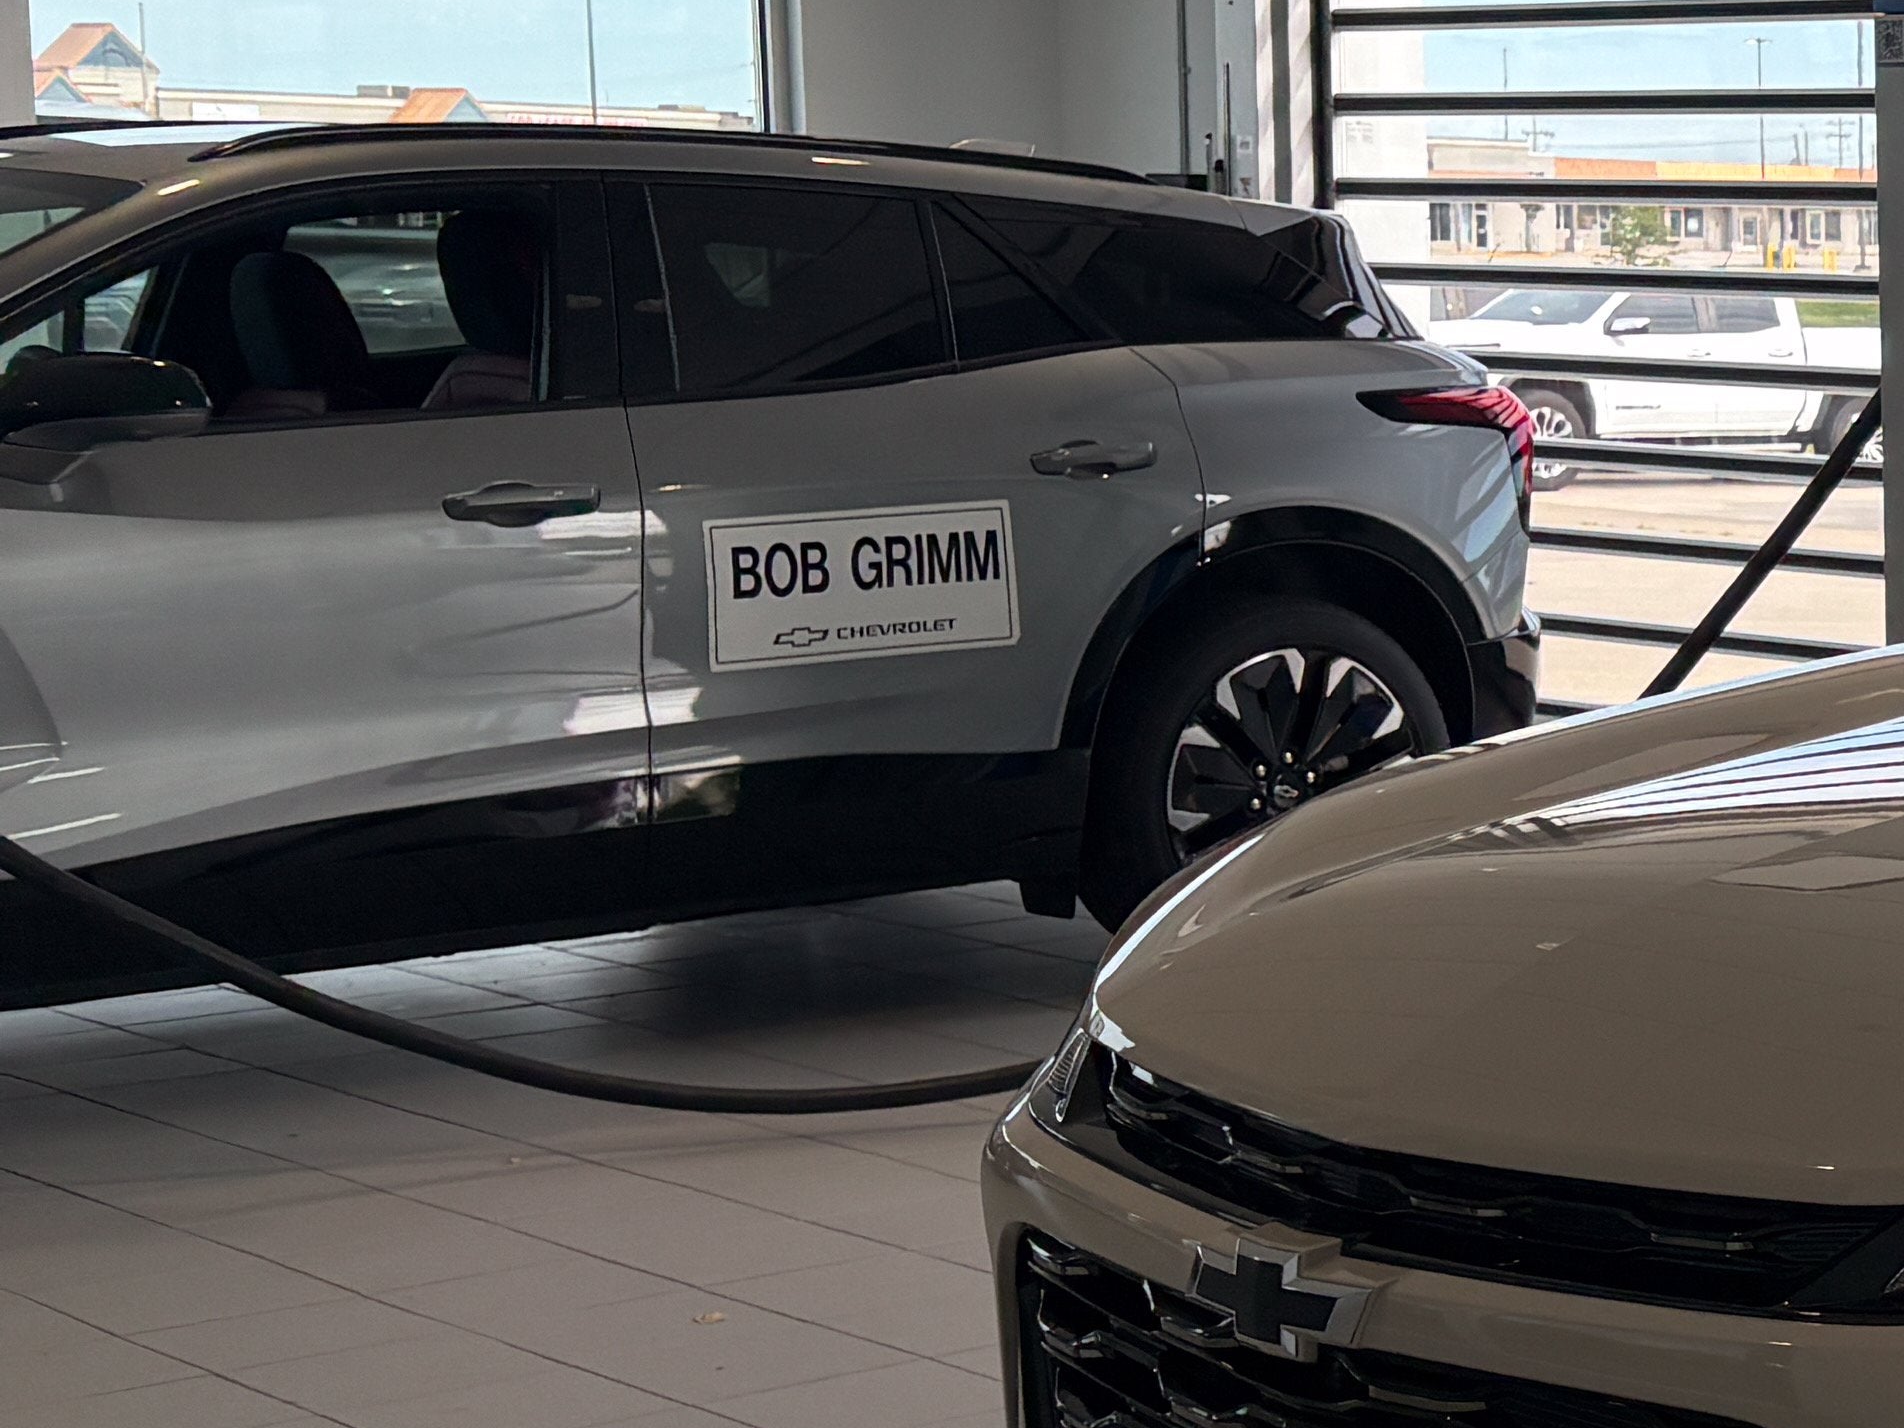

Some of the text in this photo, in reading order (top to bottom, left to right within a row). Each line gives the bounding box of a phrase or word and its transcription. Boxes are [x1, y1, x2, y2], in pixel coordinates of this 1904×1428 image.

[730, 529, 1001, 600] BOB GRIMM
[836, 618, 958, 641] CHEVROLET
